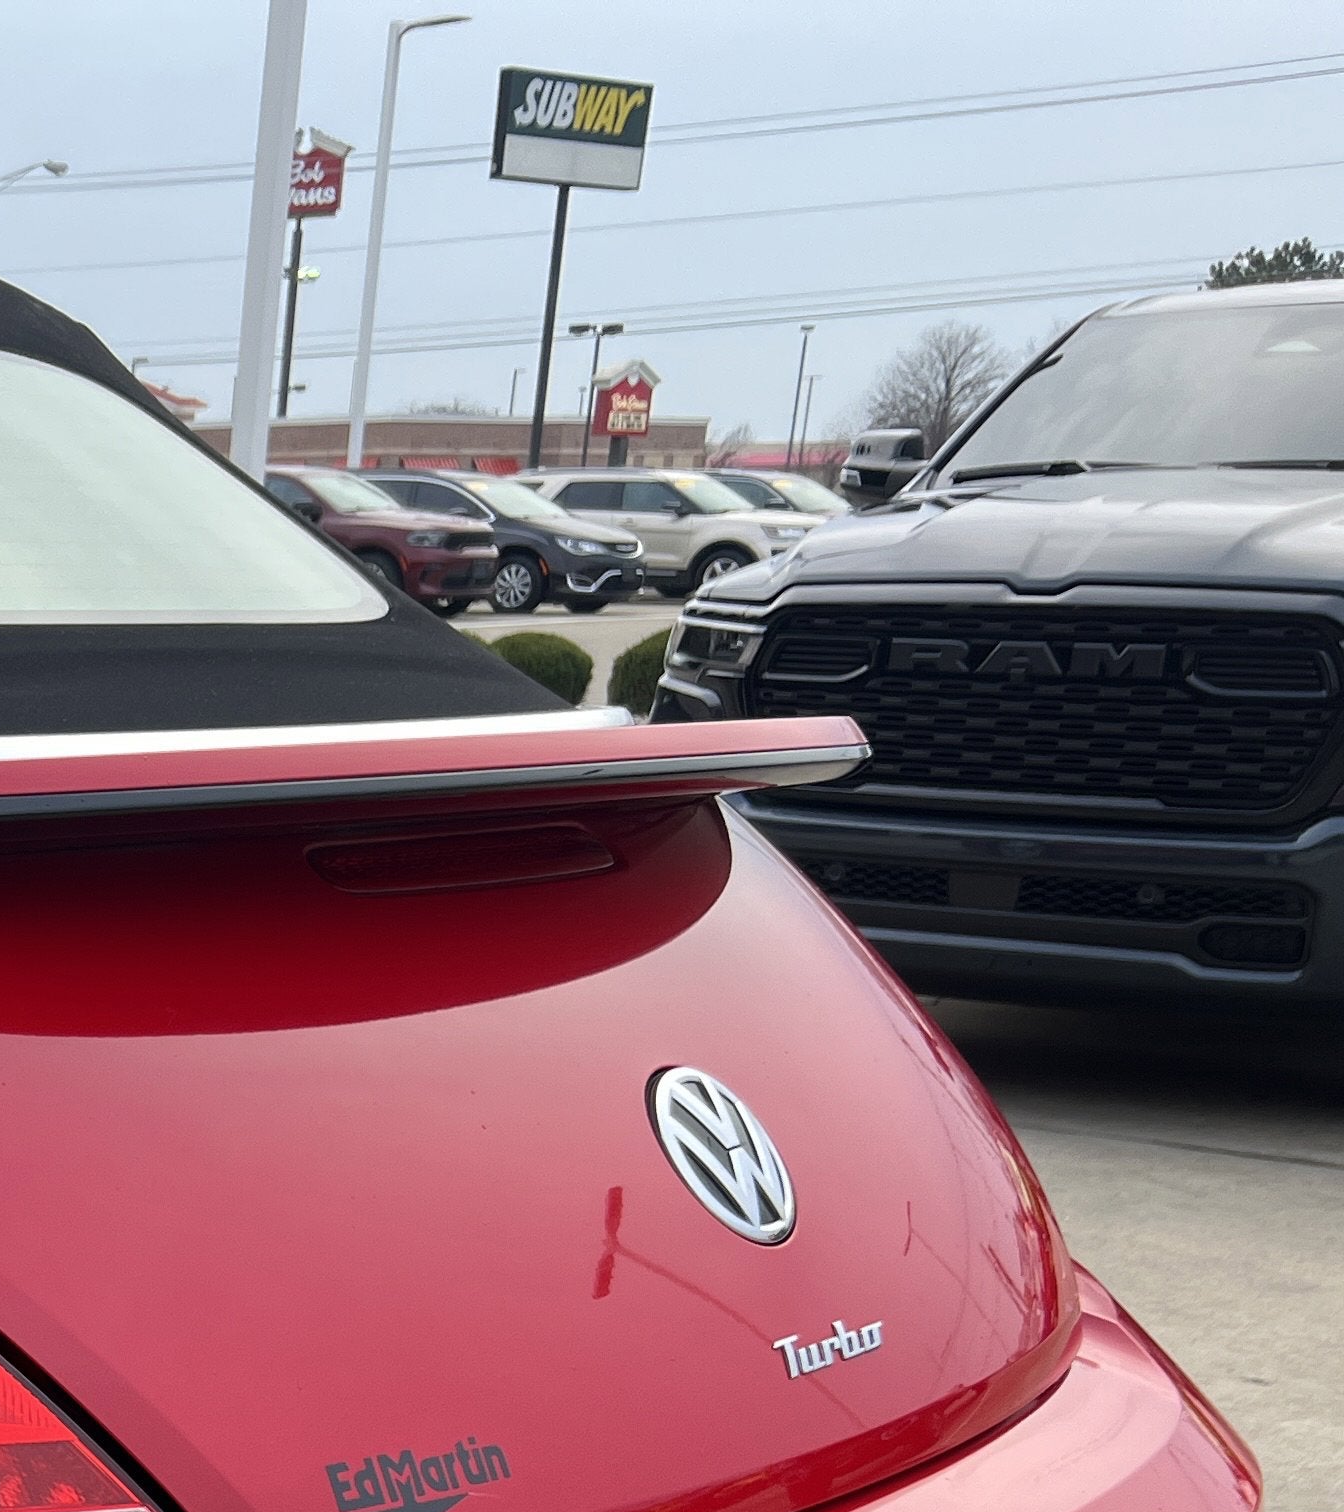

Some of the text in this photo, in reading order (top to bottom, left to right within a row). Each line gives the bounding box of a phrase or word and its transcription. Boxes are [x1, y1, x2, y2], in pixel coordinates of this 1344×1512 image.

[513, 77, 646, 136] SUBWAY
[888, 637, 1167, 679] RAM
[772, 1320, 884, 1379] Turbo
